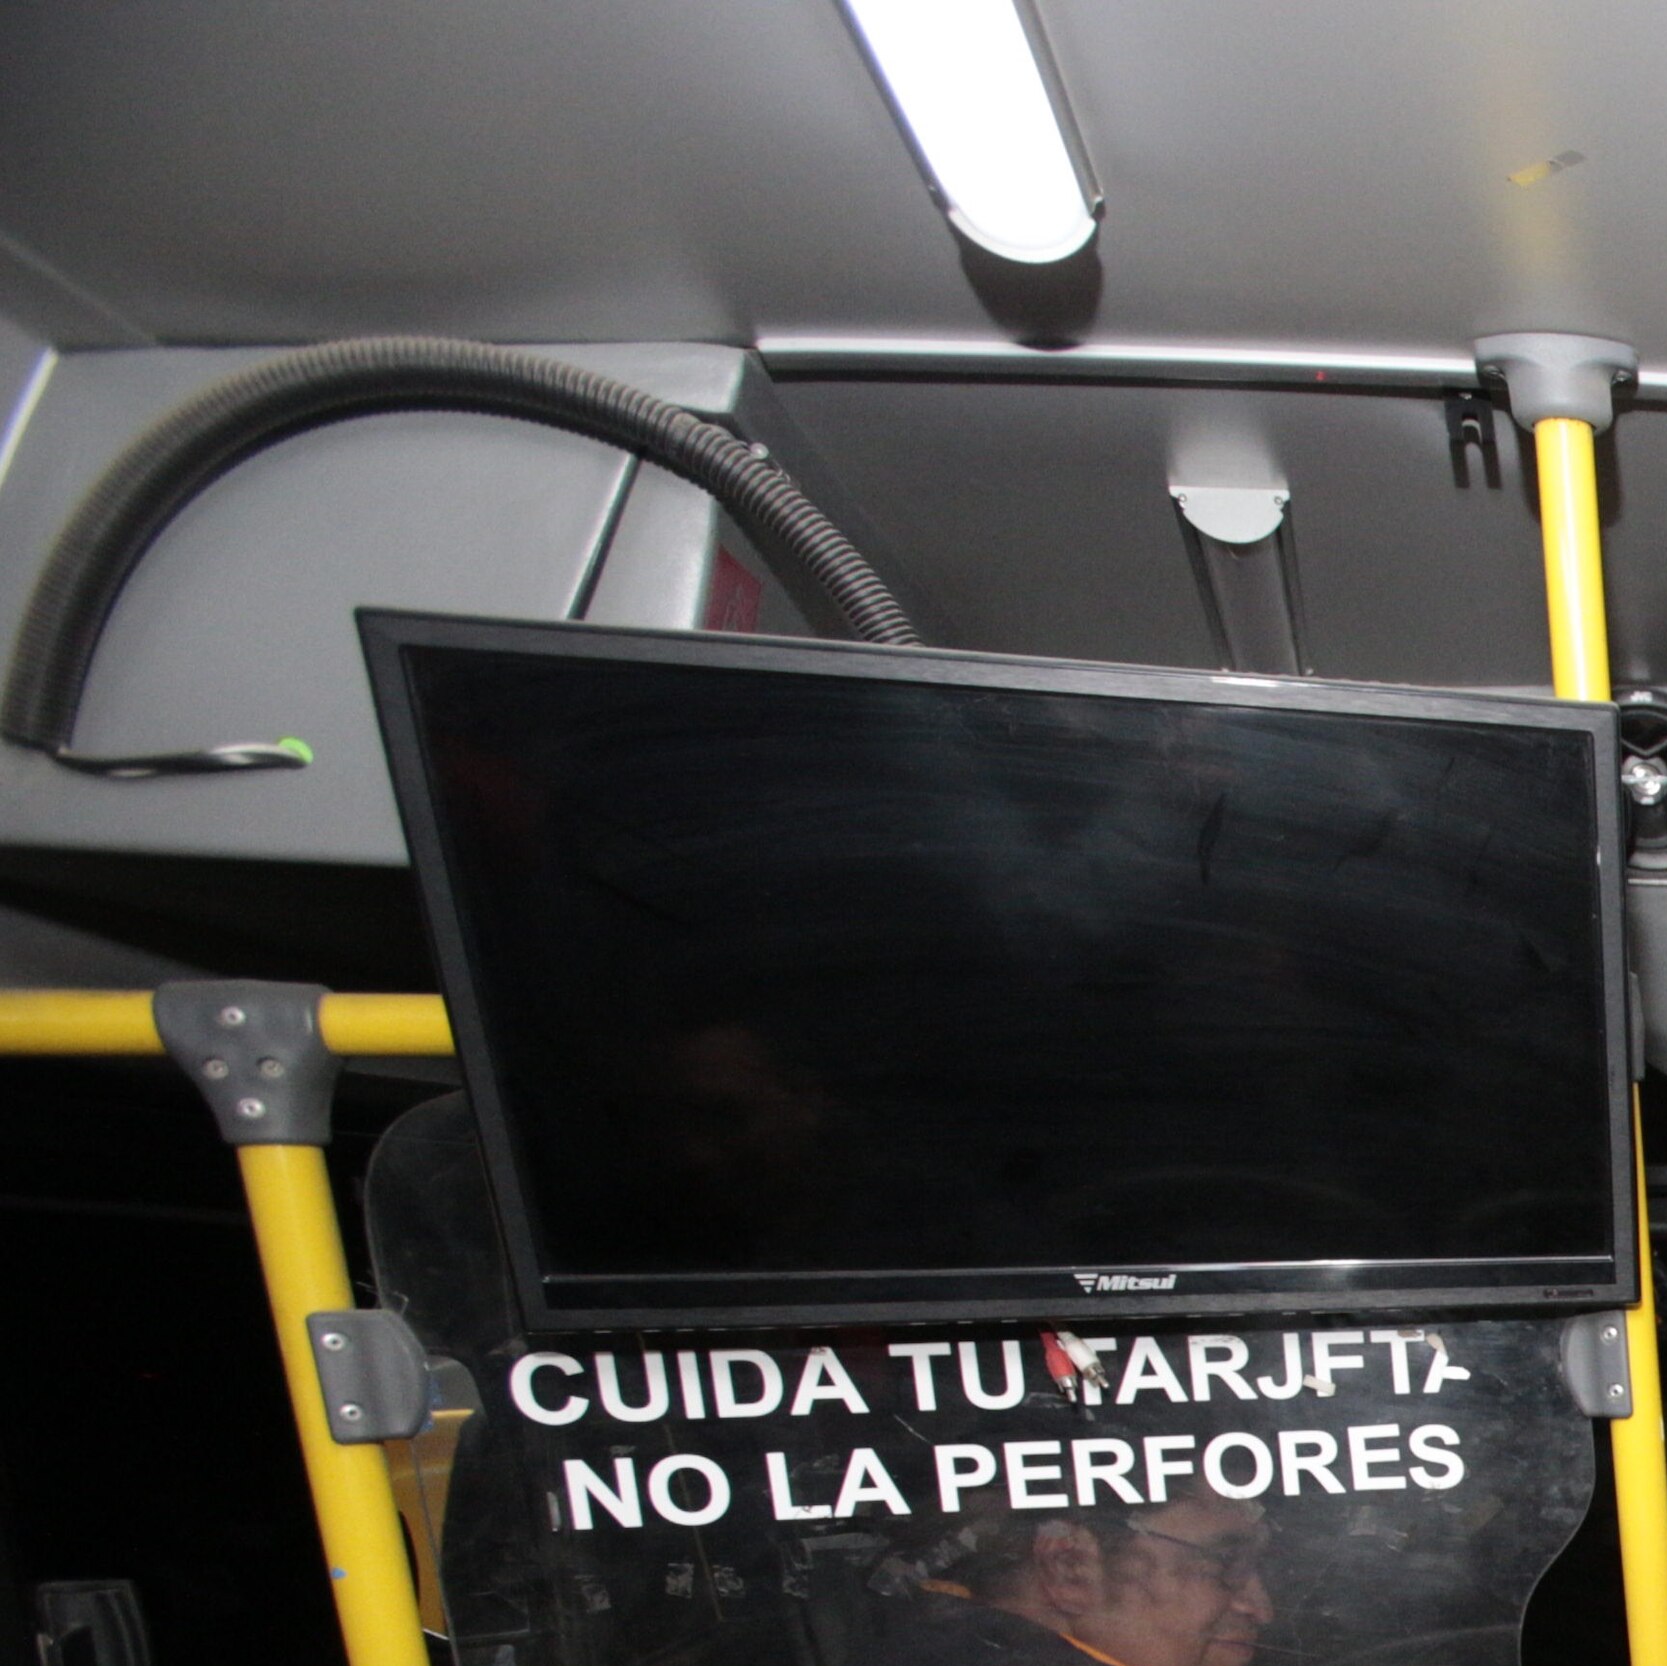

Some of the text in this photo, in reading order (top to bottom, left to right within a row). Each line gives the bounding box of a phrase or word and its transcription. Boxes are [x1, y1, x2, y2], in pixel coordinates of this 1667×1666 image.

[1096, 1273, 1177, 1292] Mitsui
[508, 1345, 871, 1426] CUIDA
[887, 1338, 1026, 1412] TU
[562, 1423, 1465, 1531] NO LA PERFORES
